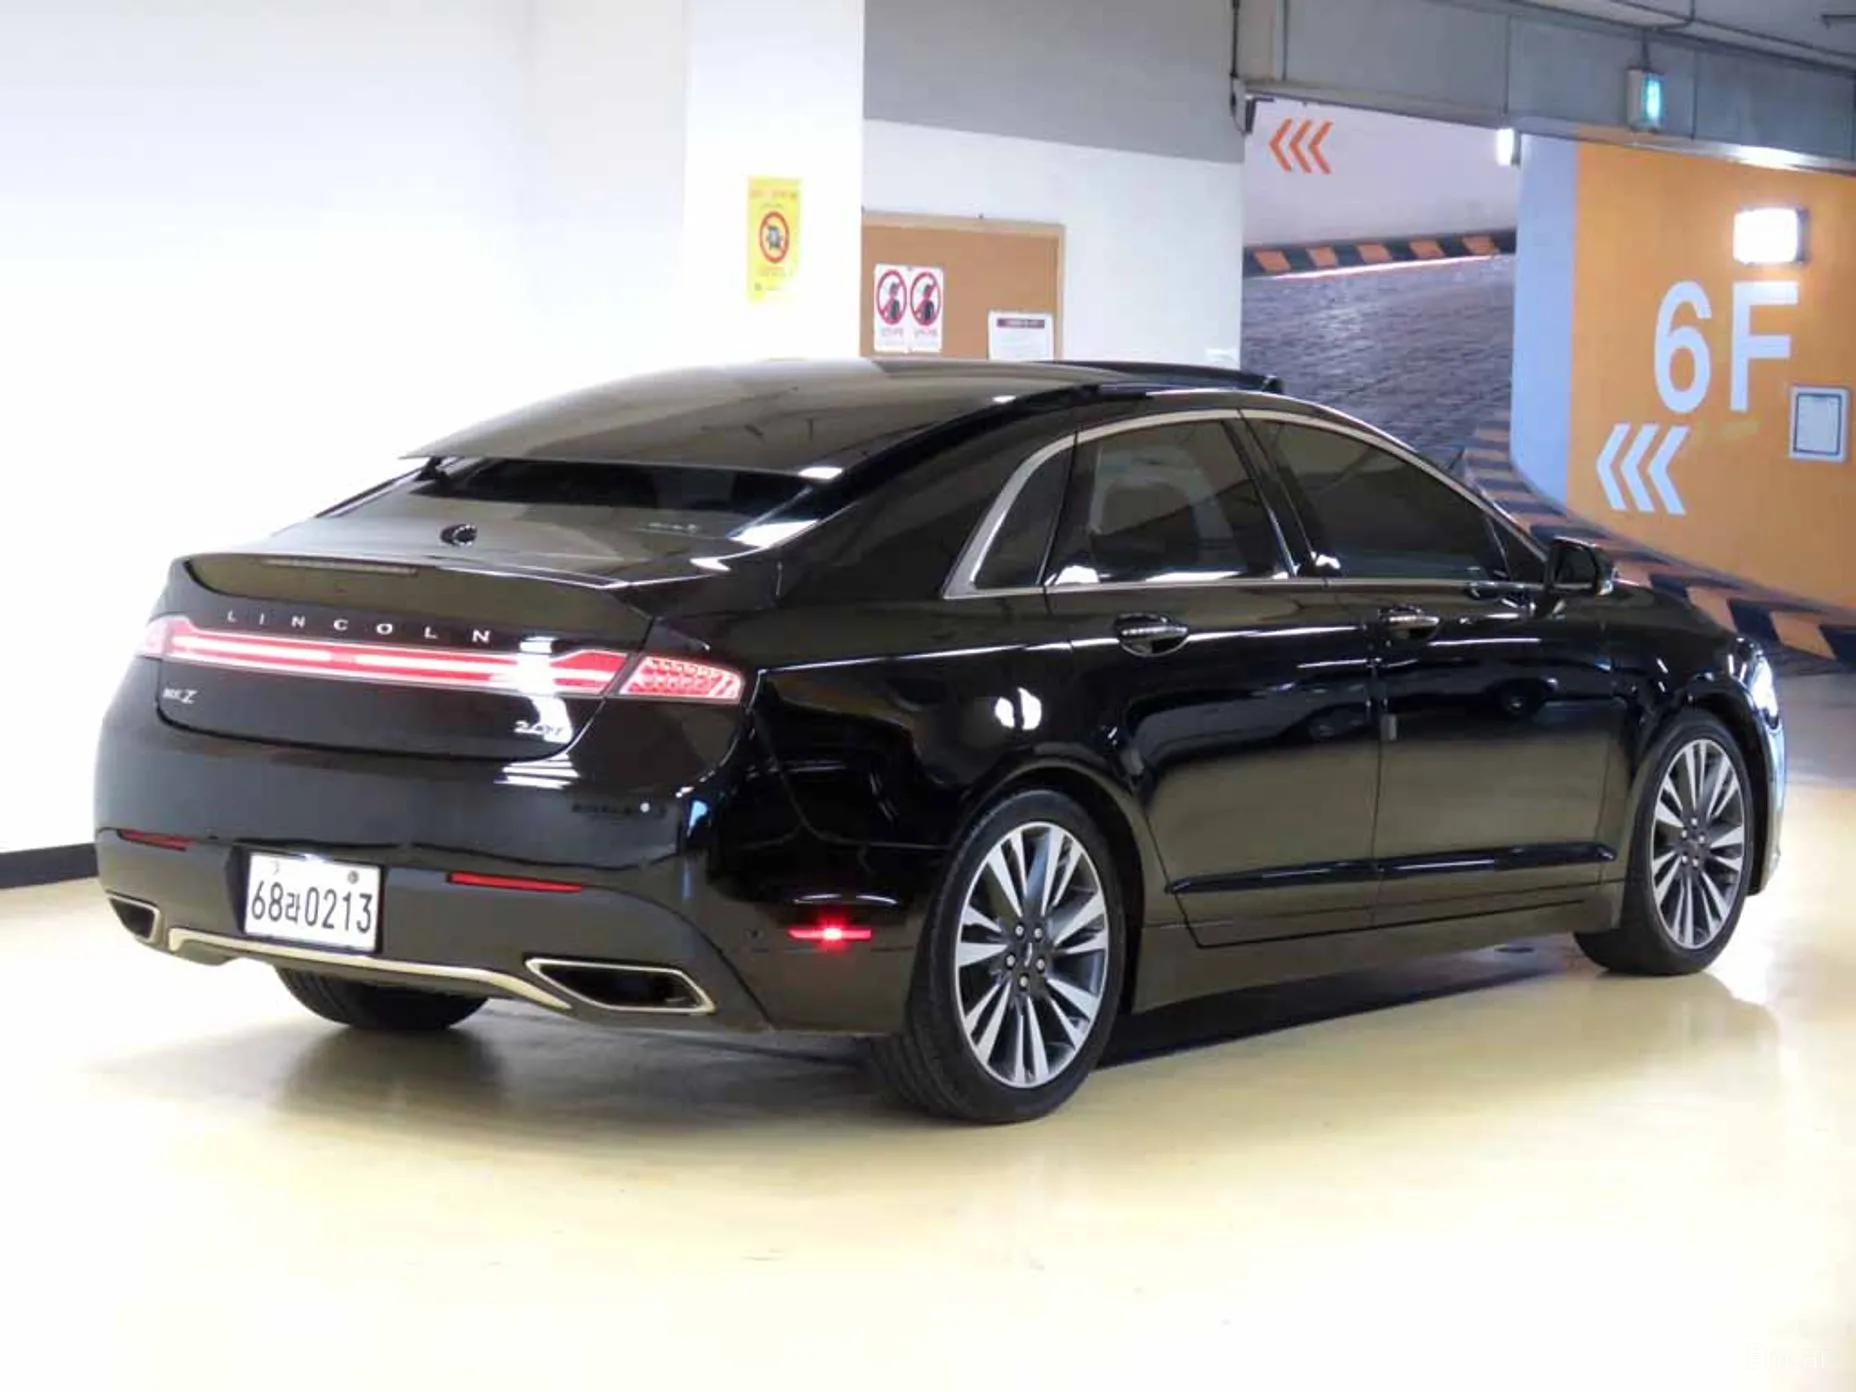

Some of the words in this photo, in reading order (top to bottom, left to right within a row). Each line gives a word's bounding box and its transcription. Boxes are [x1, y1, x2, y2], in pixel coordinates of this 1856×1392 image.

[1654, 280, 1799, 414] 6F
[227, 610, 491, 643] LINCOLN
[251, 879, 373, 934] 68라0213
